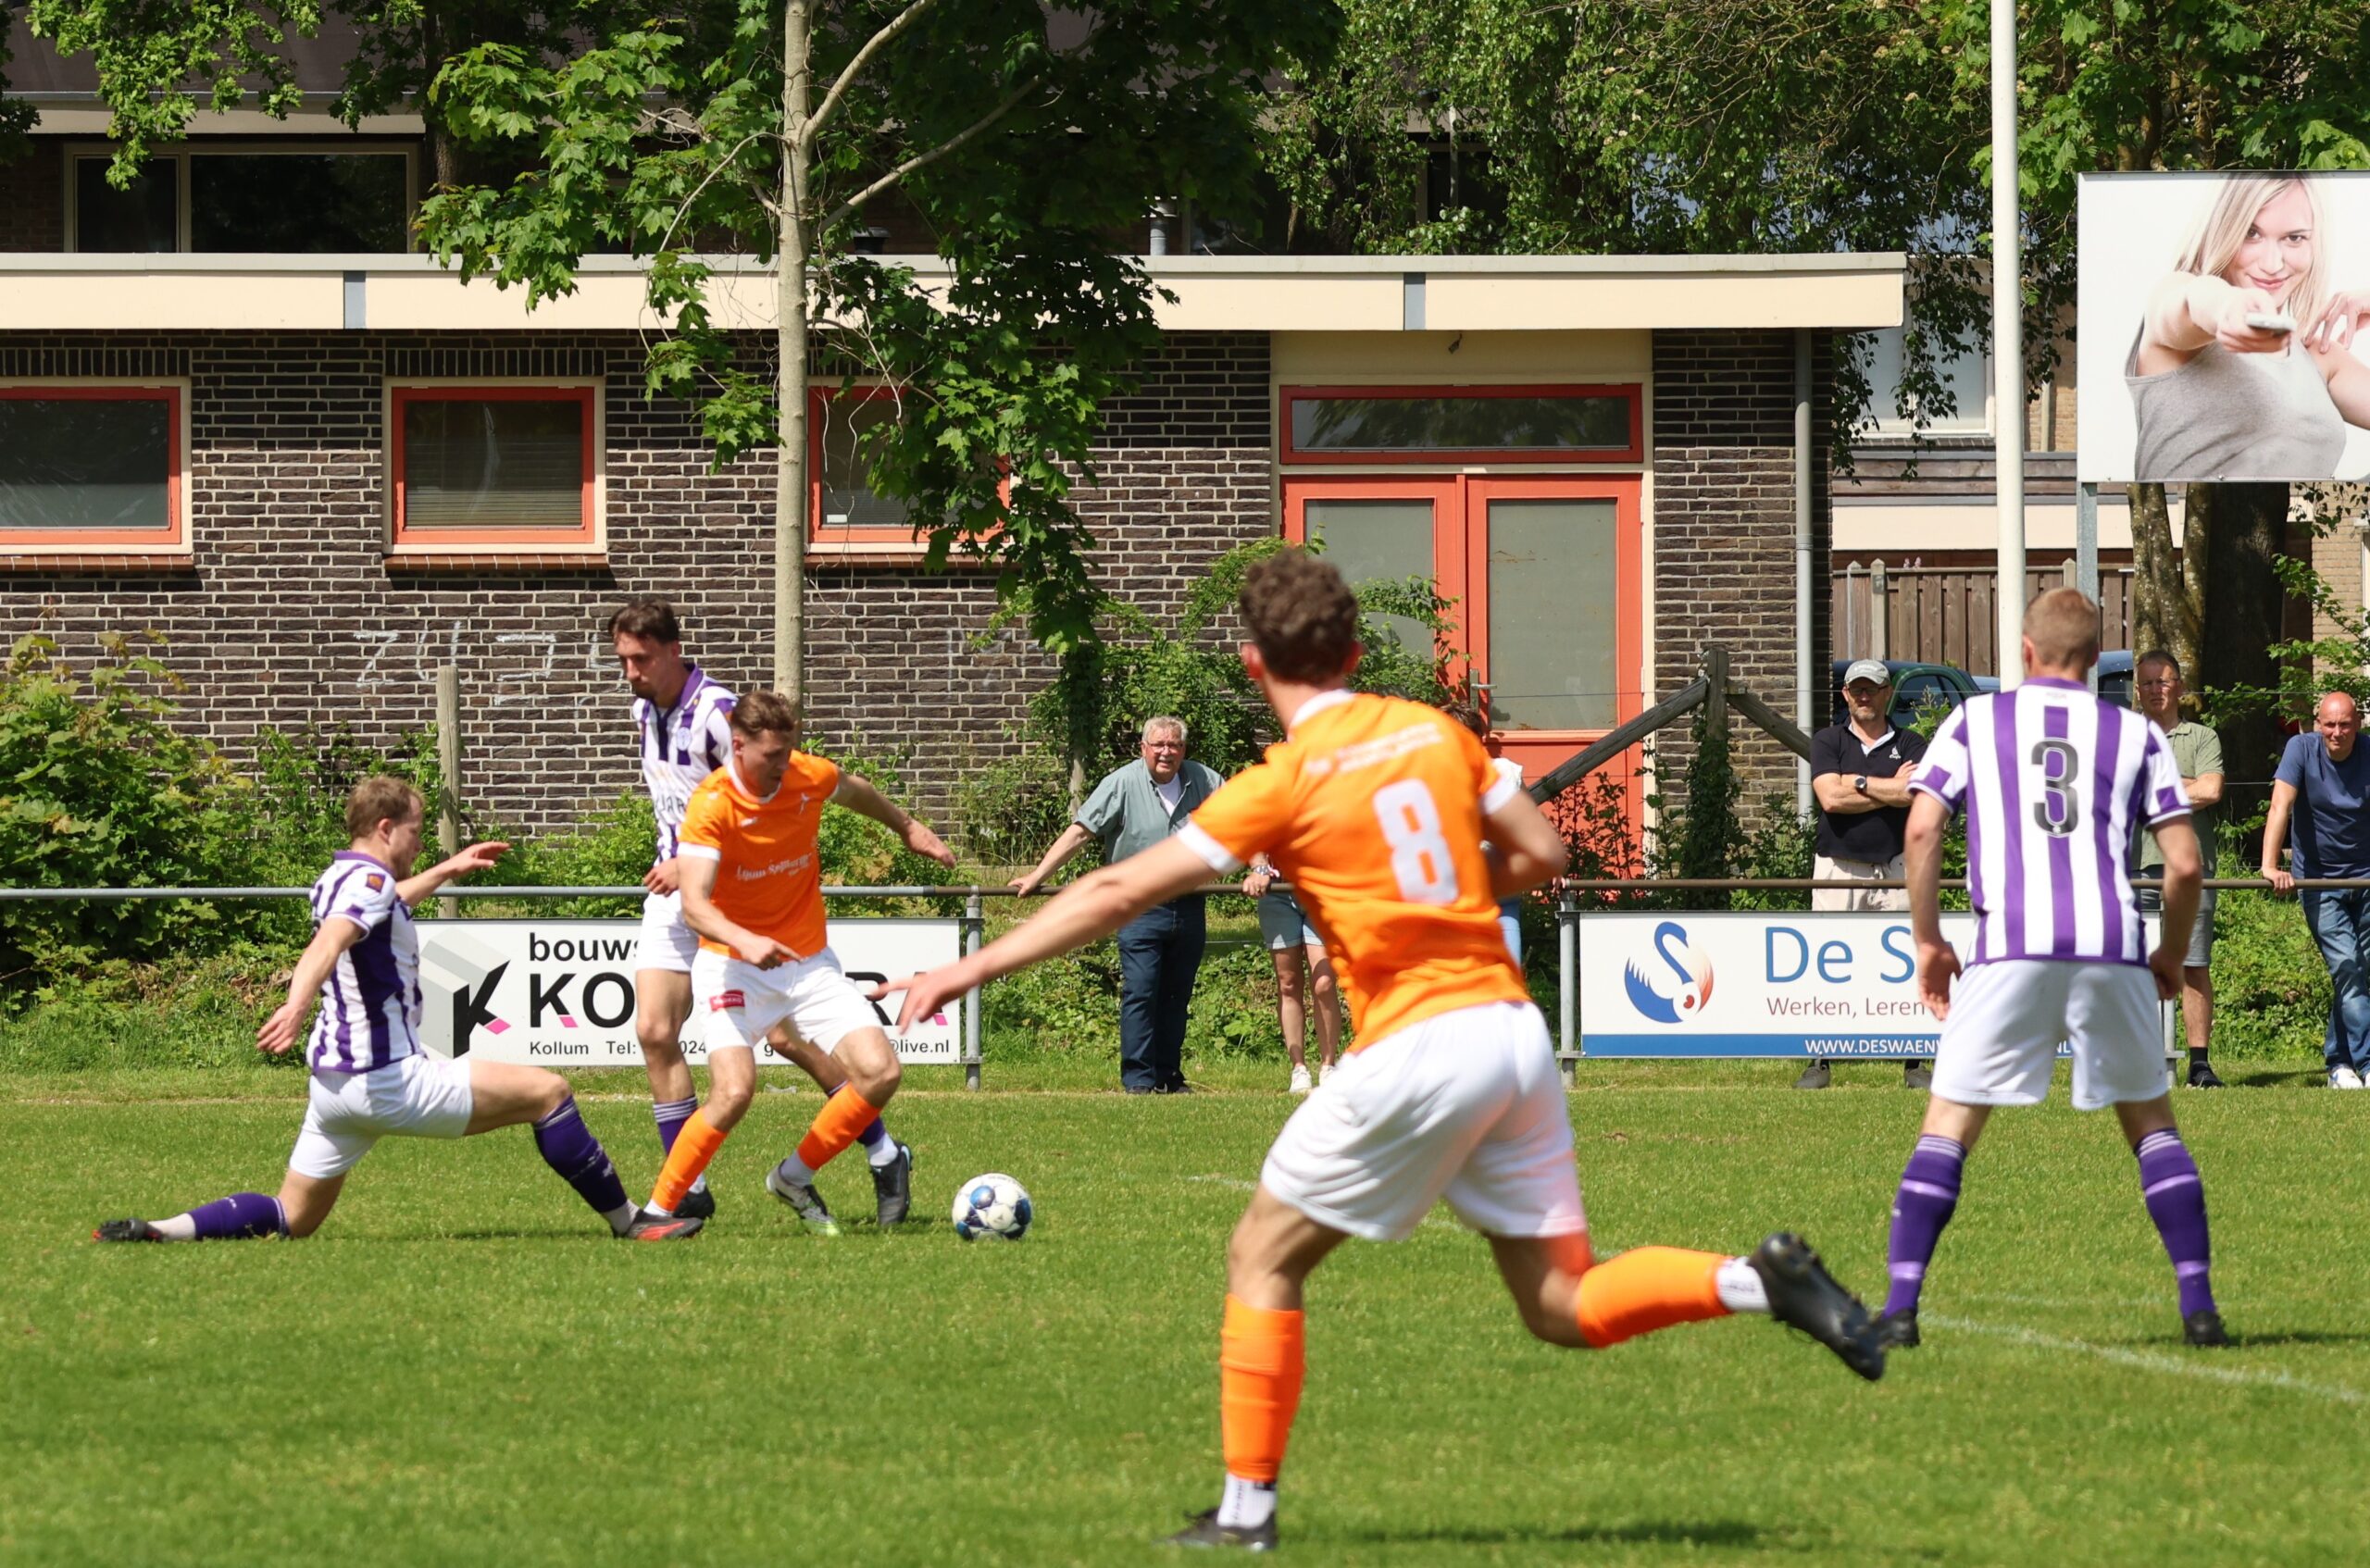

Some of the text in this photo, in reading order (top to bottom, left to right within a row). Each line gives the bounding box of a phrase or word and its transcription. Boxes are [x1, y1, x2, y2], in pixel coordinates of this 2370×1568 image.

[2030, 737, 2079, 839] 3
[1372, 777, 1460, 905] 8
[1765, 927, 1852, 983] De
[1766, 996, 1926, 1019] Werken, Leren
[530, 1040, 590, 1055] Kollum
[605, 1040, 637, 1055] Tel:
